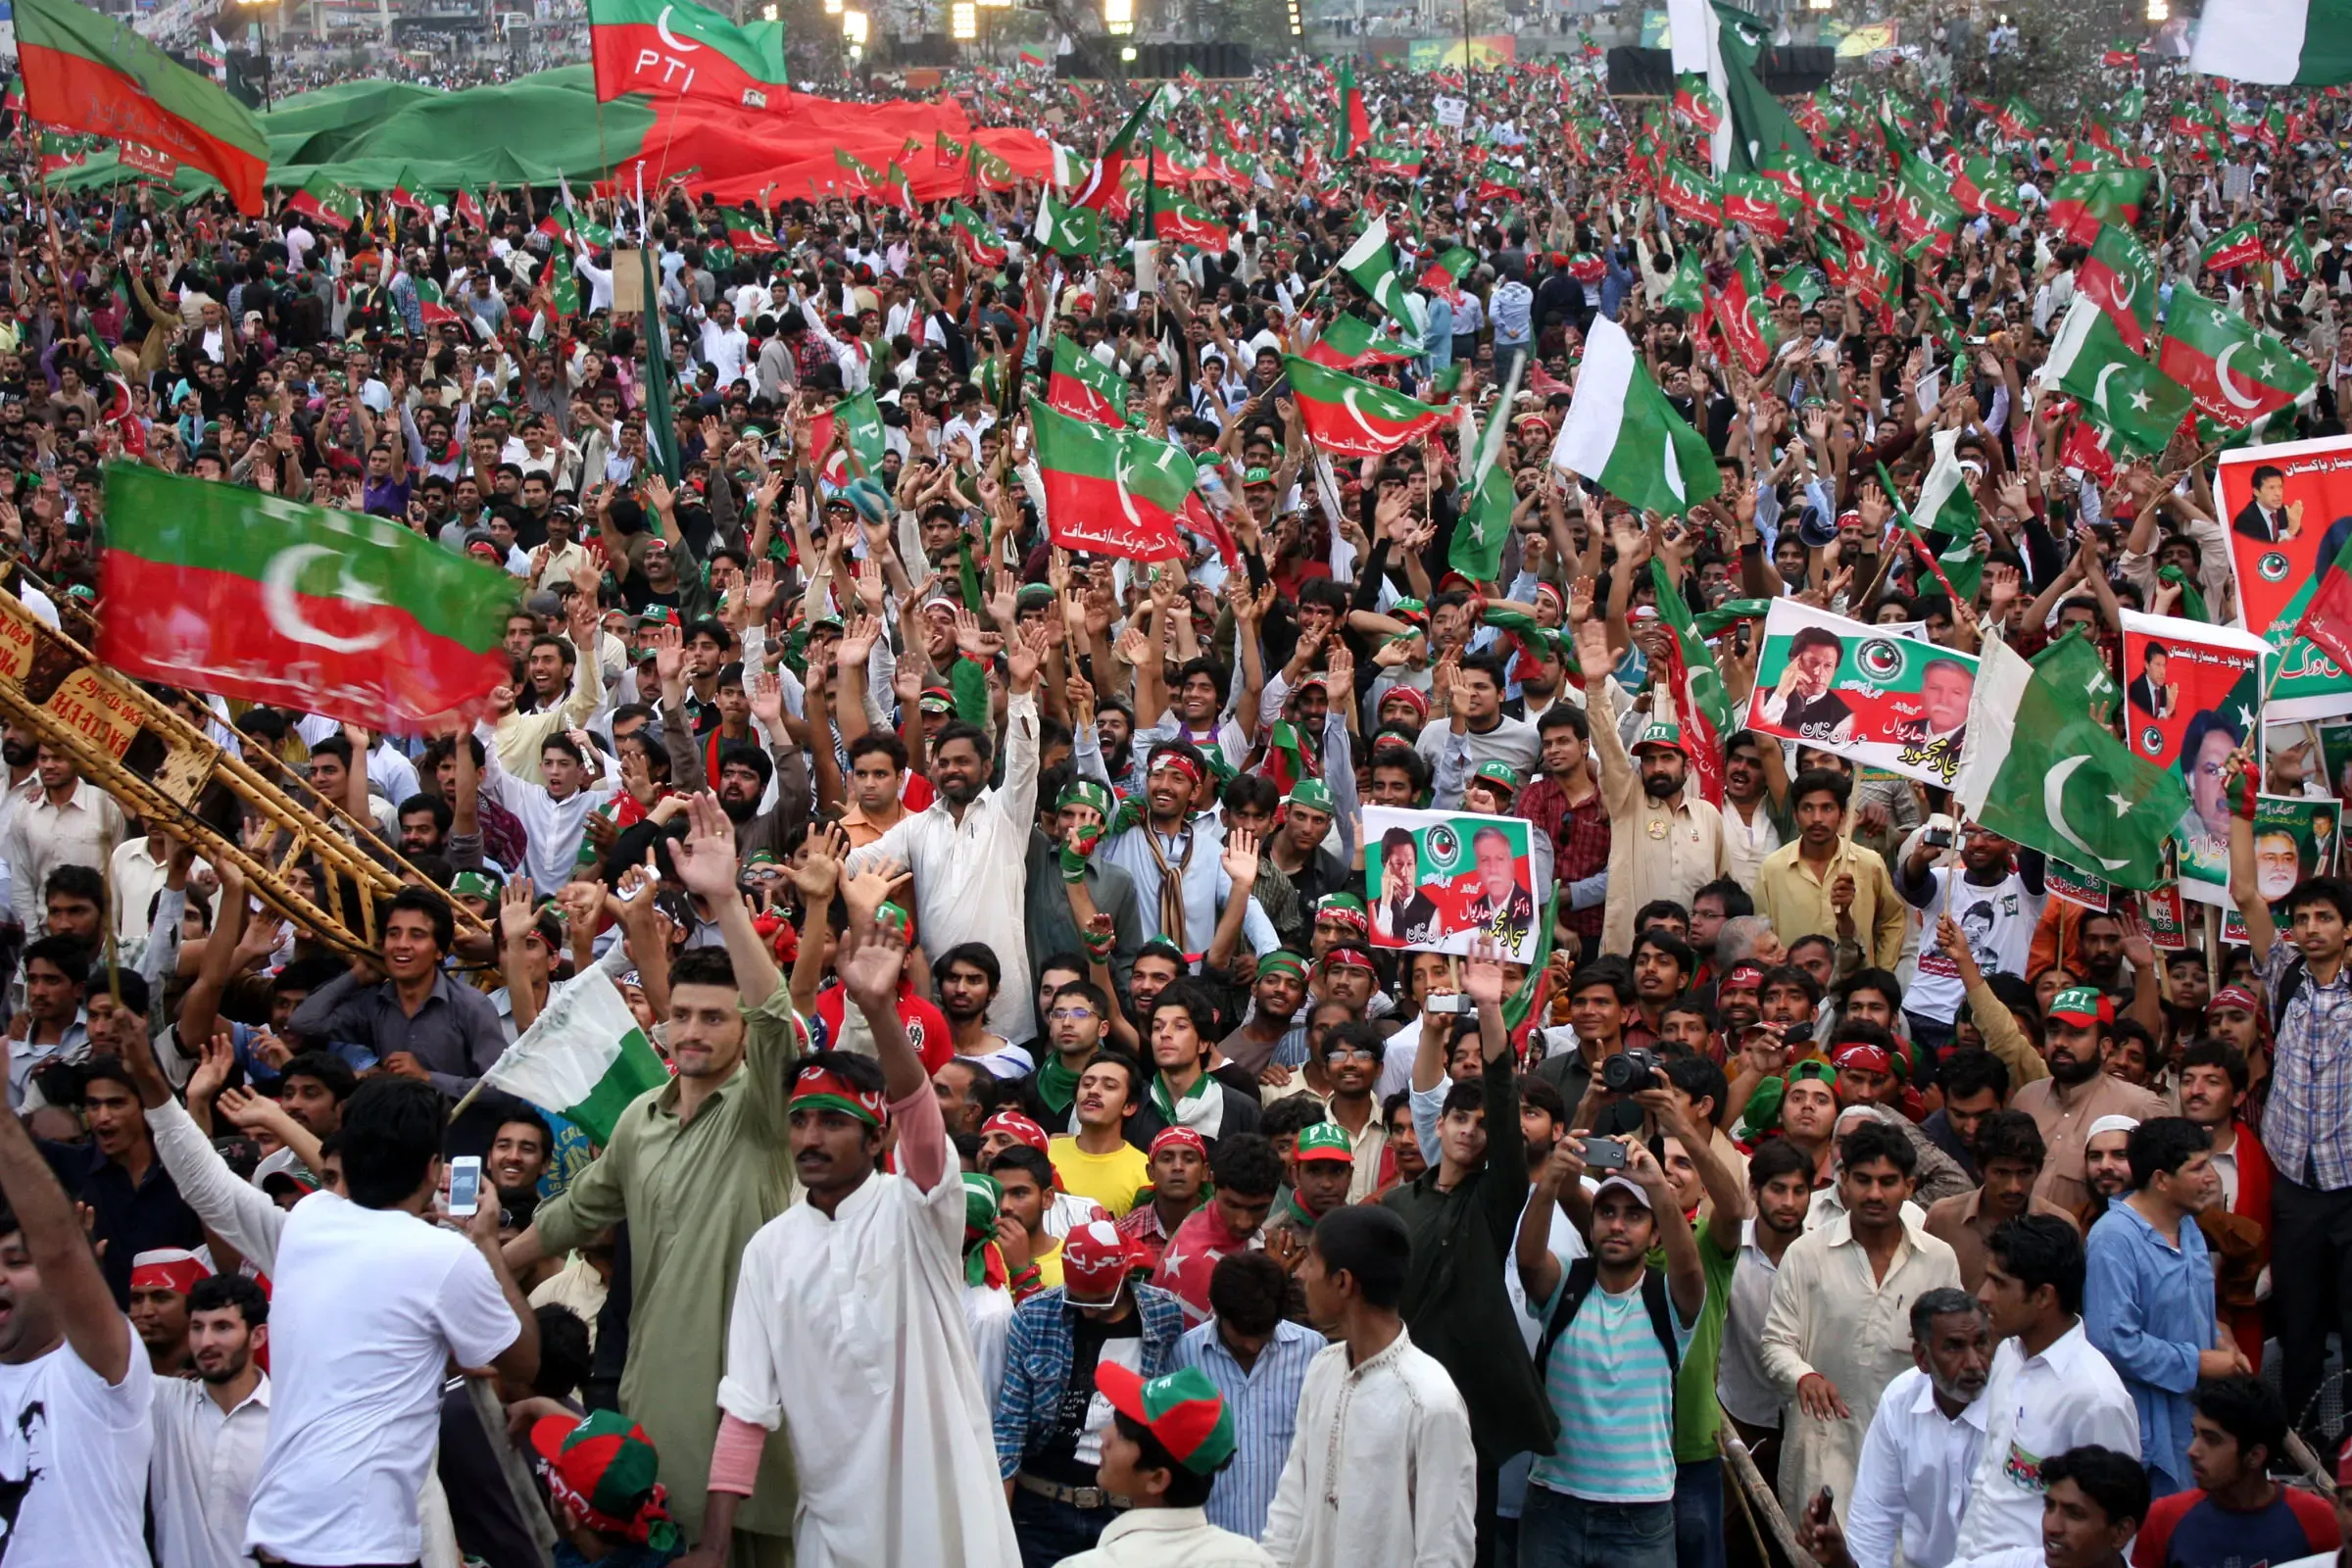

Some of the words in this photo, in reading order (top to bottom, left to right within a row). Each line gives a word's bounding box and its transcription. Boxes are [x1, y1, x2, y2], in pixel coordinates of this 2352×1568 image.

[635, 49, 695, 92] PTI
[2003, 103, 2029, 126] ISF
[1669, 170, 1712, 205] ISF
[1739, 177, 1782, 192] PTI
[1895, 180, 1945, 231] ISF
[1074, 357, 1122, 400] PTI
[1248, 467, 1264, 478] PTI
[2285, 459, 2328, 476] پاکستان
[1061, 521, 1112, 543] انصاف
[2168, 646, 2197, 662] پاکستان
[1800, 721, 1830, 740] خان
[1829, 729, 1867, 753] عمران
[1898, 738, 1947, 764] محمود
[1486, 762, 1511, 778] PTI
[2085, 873, 2100, 889] 85
[2156, 907, 2171, 916] NA
[1405, 922, 1427, 944] خان
[2156, 918, 2173, 930] 85
[1427, 926, 1454, 949] عمران
[2053, 990, 2088, 1005] PTI
[1308, 1124, 1344, 1140] PTI
[1061, 1242, 1127, 1275] تحریک
